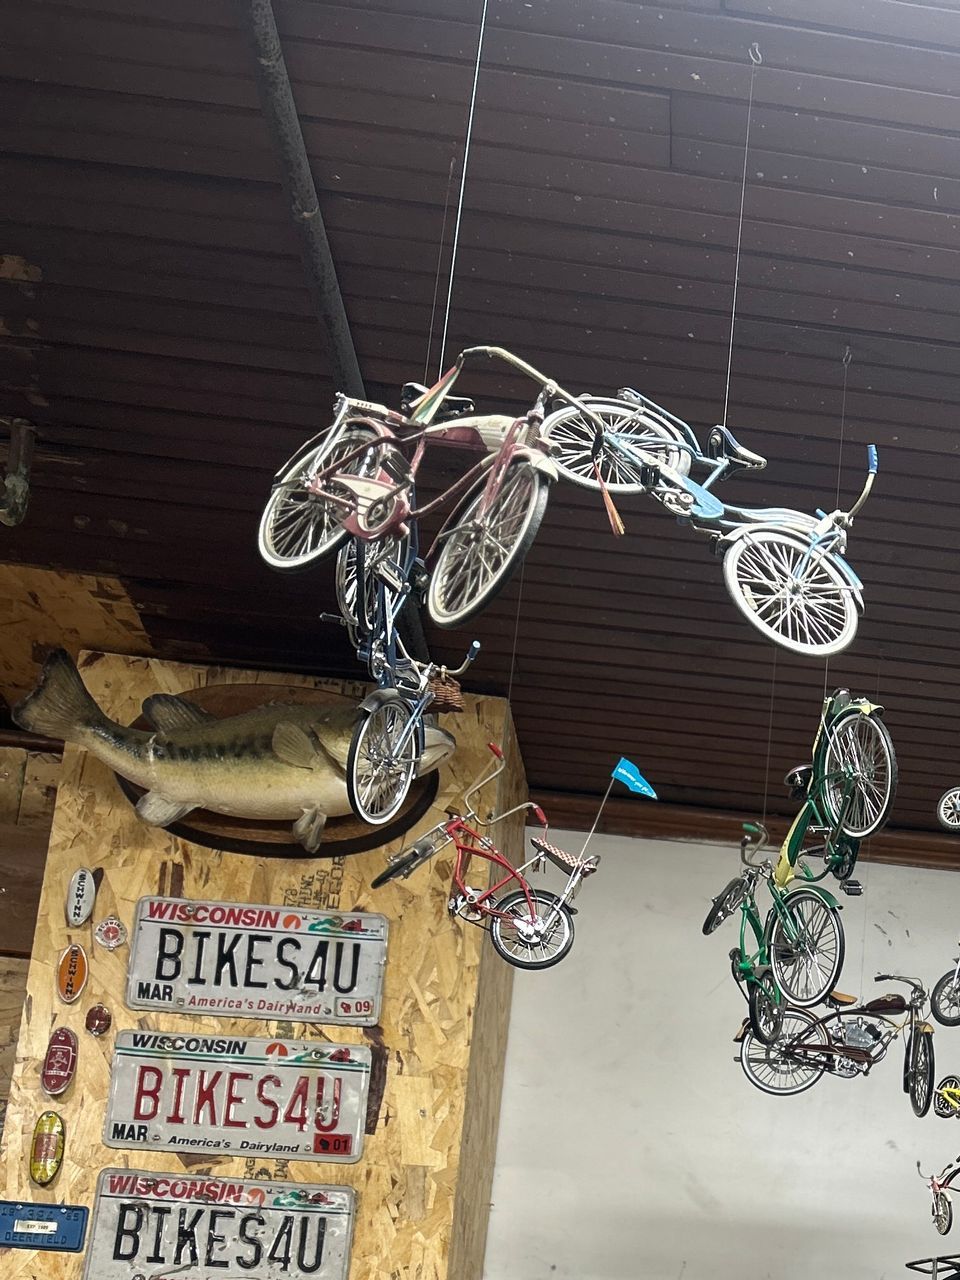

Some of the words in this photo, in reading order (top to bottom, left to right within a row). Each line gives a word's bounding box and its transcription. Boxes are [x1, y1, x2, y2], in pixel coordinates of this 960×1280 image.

[73, 873, 87, 918] SCHWINN
[149, 902, 280, 928] WISCONSIN
[155, 927, 361, 994] BIKES4U
[65, 950, 79, 995] SCHWINN
[137, 982, 173, 1001] MAR
[188, 995, 253, 1010] America's
[257, 1000, 321, 1016] Dairyland
[355, 1001, 370, 1013] 09
[132, 1033, 247, 1055] WISCONSIN
[133, 1065, 342, 1132] BIKES4U
[112, 1123, 148, 1141] MAR
[168, 1135, 231, 1149] America's
[239, 1140, 300, 1154] Dairyland
[333, 1140, 349, 1151] 01
[109, 1175, 244, 1203] WISCONSIN
[4, 1232, 67, 1245] DEERFIELD
[113, 1203, 327, 1274] BIKES4U
